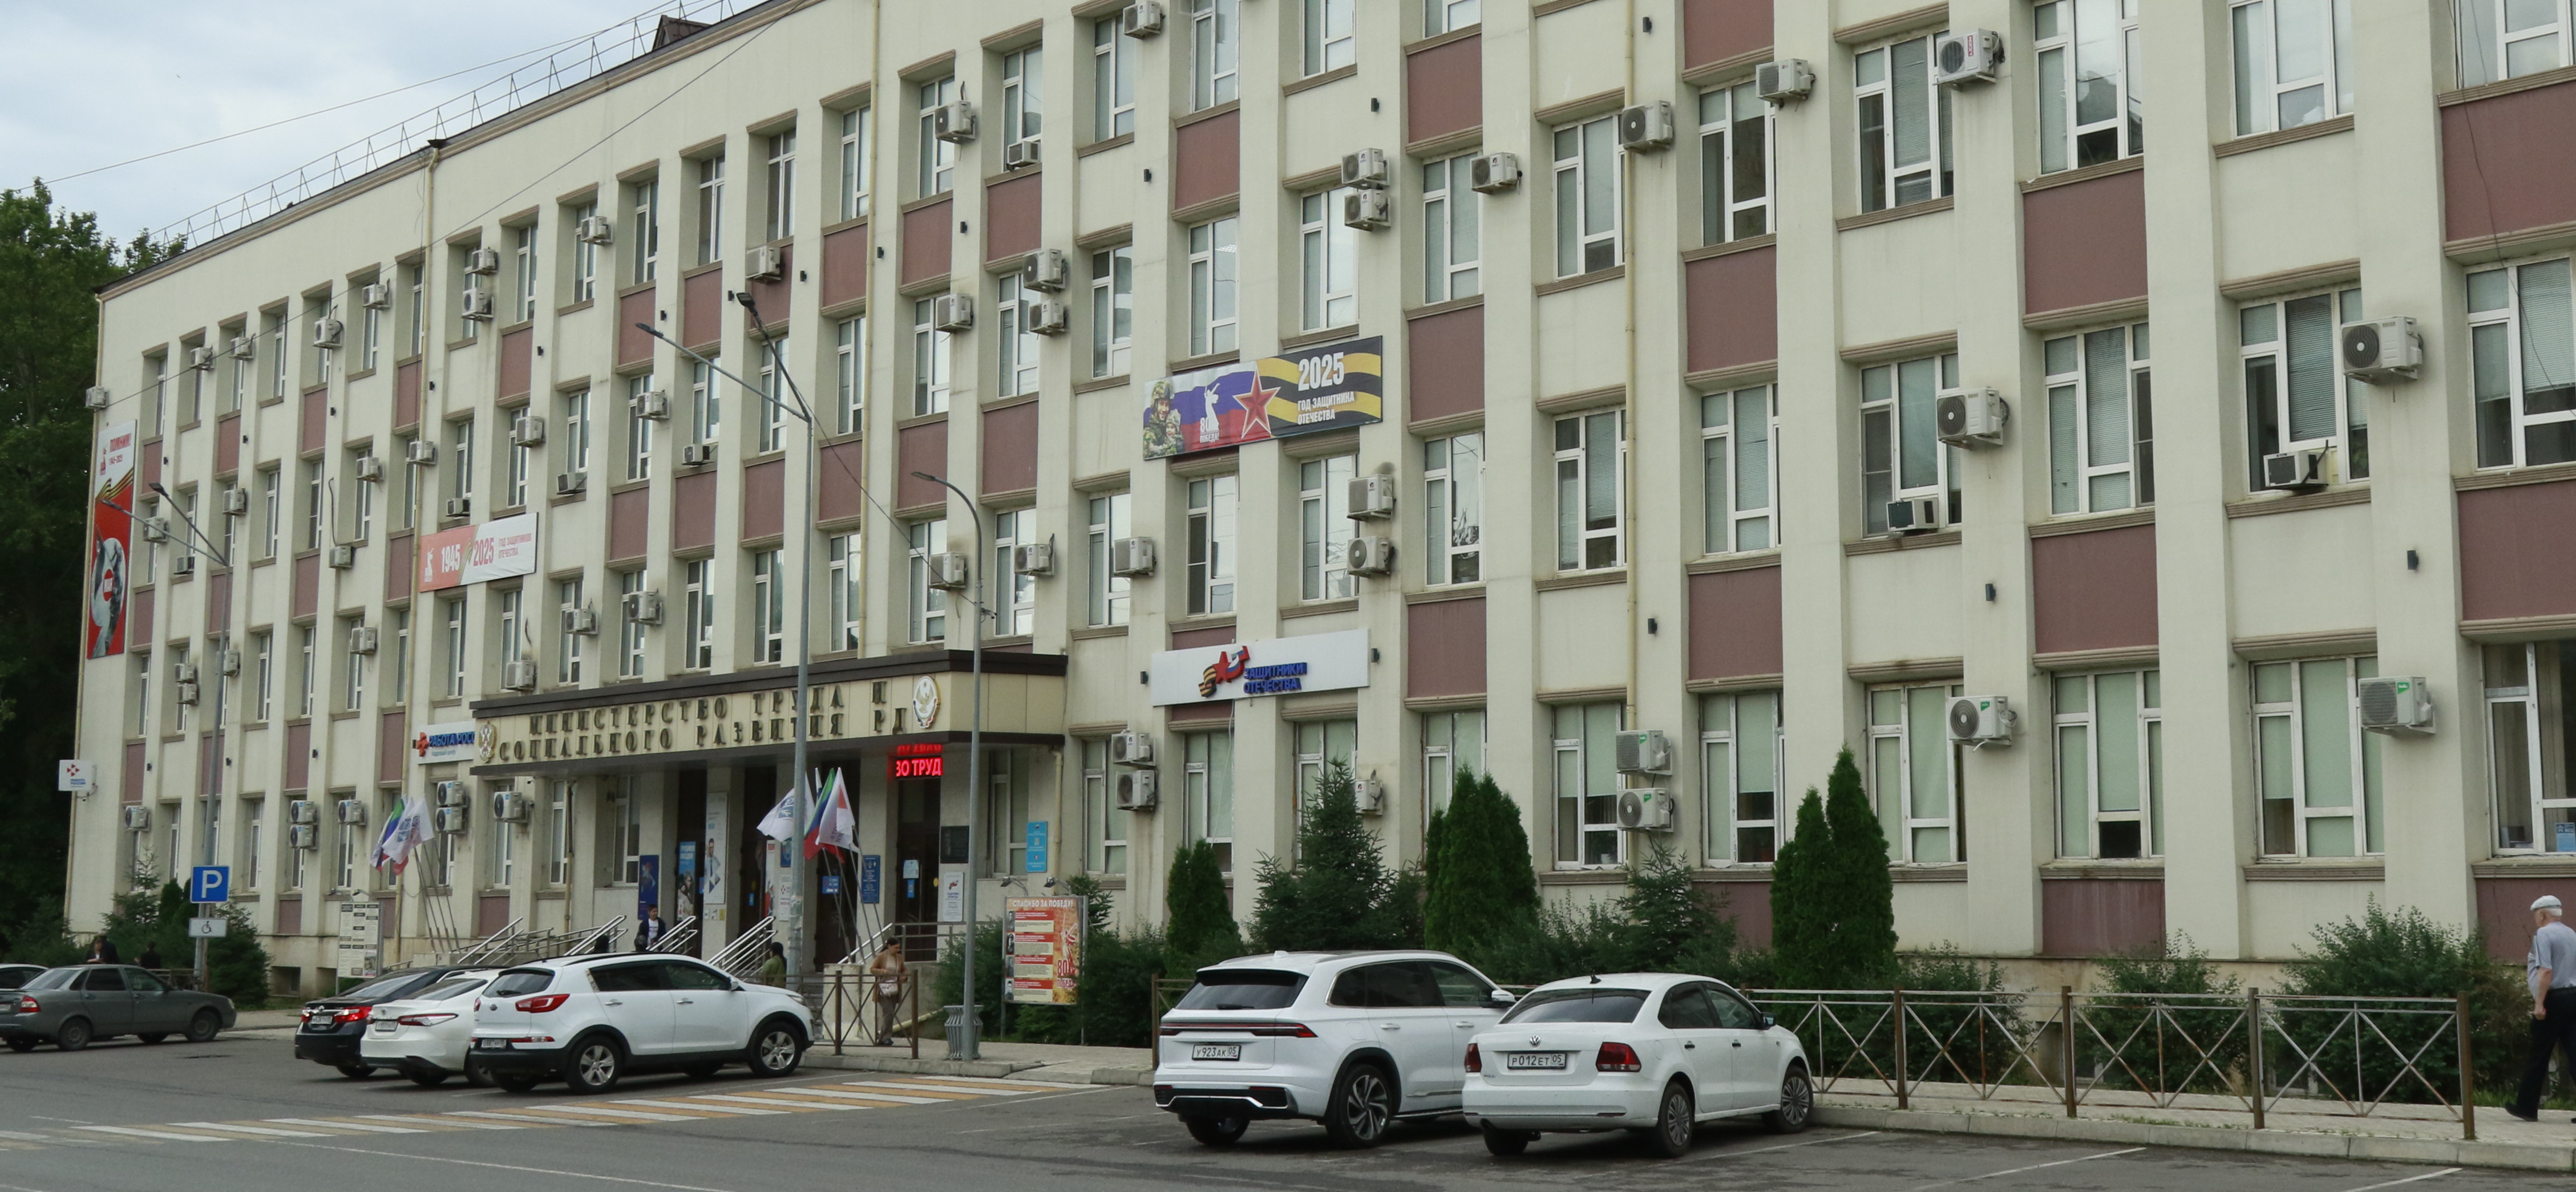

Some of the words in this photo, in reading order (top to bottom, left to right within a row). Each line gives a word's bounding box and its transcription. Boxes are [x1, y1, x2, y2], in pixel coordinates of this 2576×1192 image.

[1298, 351, 1344, 391] 2025
[1298, 399, 1311, 411] ГОД
[1312, 391, 1354, 408] ЗАЩИТНИКА
[1298, 409, 1335, 425] ОТЕЧЕСТВА
[441, 544, 461, 573] 1945
[473, 537, 494, 566] 2025
[1244, 662, 1307, 679] ЗАЩИТНИКИ
[1243, 678, 1302, 694] ОТЕЧЕСТВА
[529, 696, 727, 735] МИНИСТЕРСТВО
[872, 681, 887, 703] И
[429, 733, 456, 747] РАБОТА
[499, 727, 673, 761] СОЦИАЛЬНОГО
[874, 708, 906, 735] РД
[911, 757, 943, 776] ТРУД
[201, 870, 223, 898] P
[1049, 899, 1073, 908] ПОБЕДУ!
